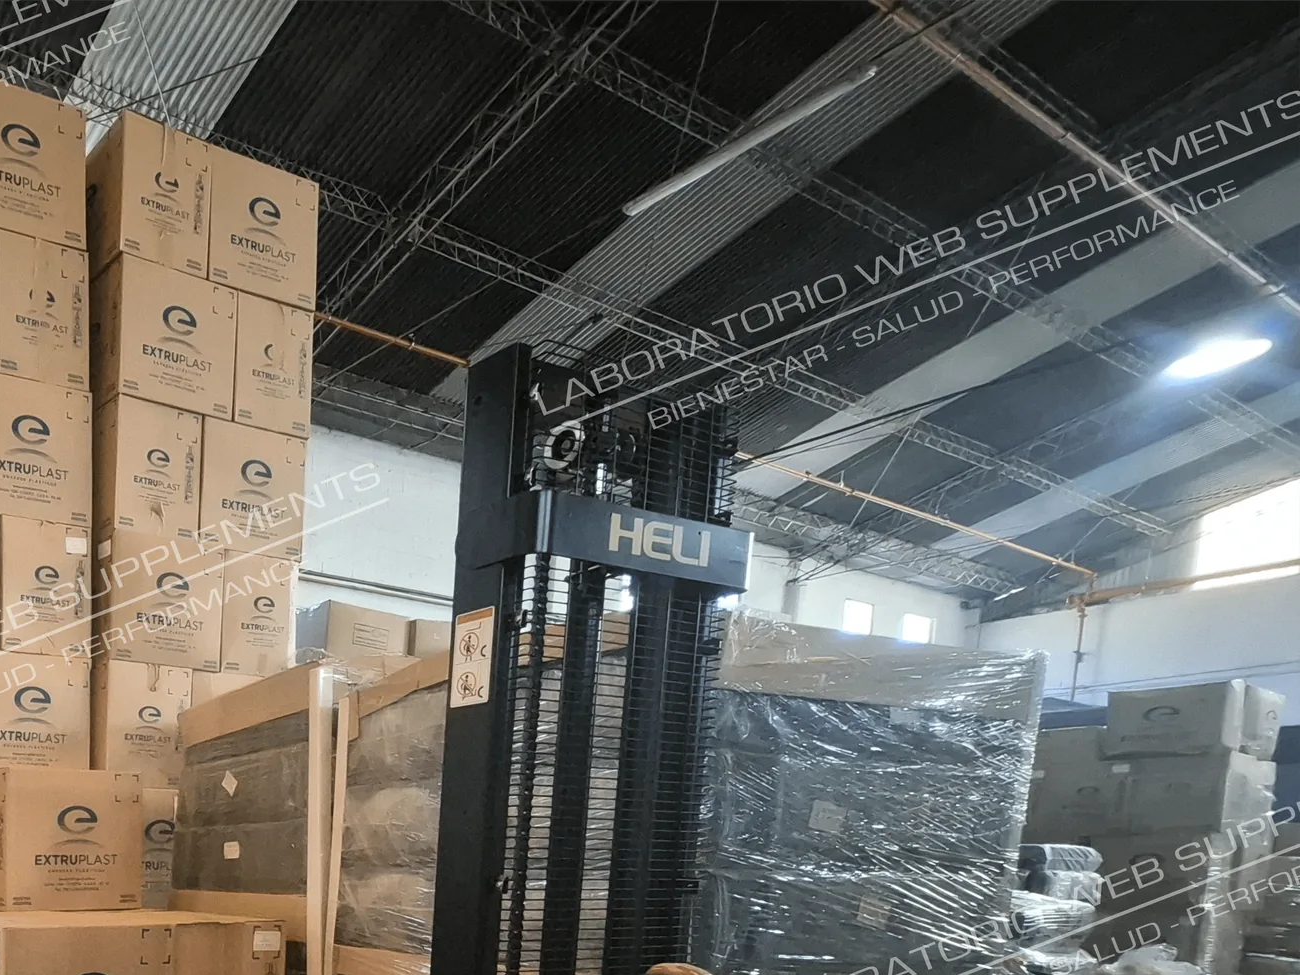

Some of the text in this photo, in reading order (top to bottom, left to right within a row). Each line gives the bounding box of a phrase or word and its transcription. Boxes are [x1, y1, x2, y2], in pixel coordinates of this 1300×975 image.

[140, 196, 191, 220] EXTRUPLAST
[230, 234, 296, 264] EXTRUPLAST
[142, 344, 213, 374] EXTRUPLAST
[133, 475, 180, 492] EXTRUPLAST
[221, 498, 286, 519] EXTRUPLAST
[609, 513, 711, 567] HELI
[20, 594, 71, 608] EXTRUPLAST
[136, 612, 205, 632] EXTRUPLAST
[240, 622, 285, 634] EXTRUPLAST
[124, 733, 172, 744] EXTRUPLAST
[34, 854, 119, 867] EXTRUPLAST
